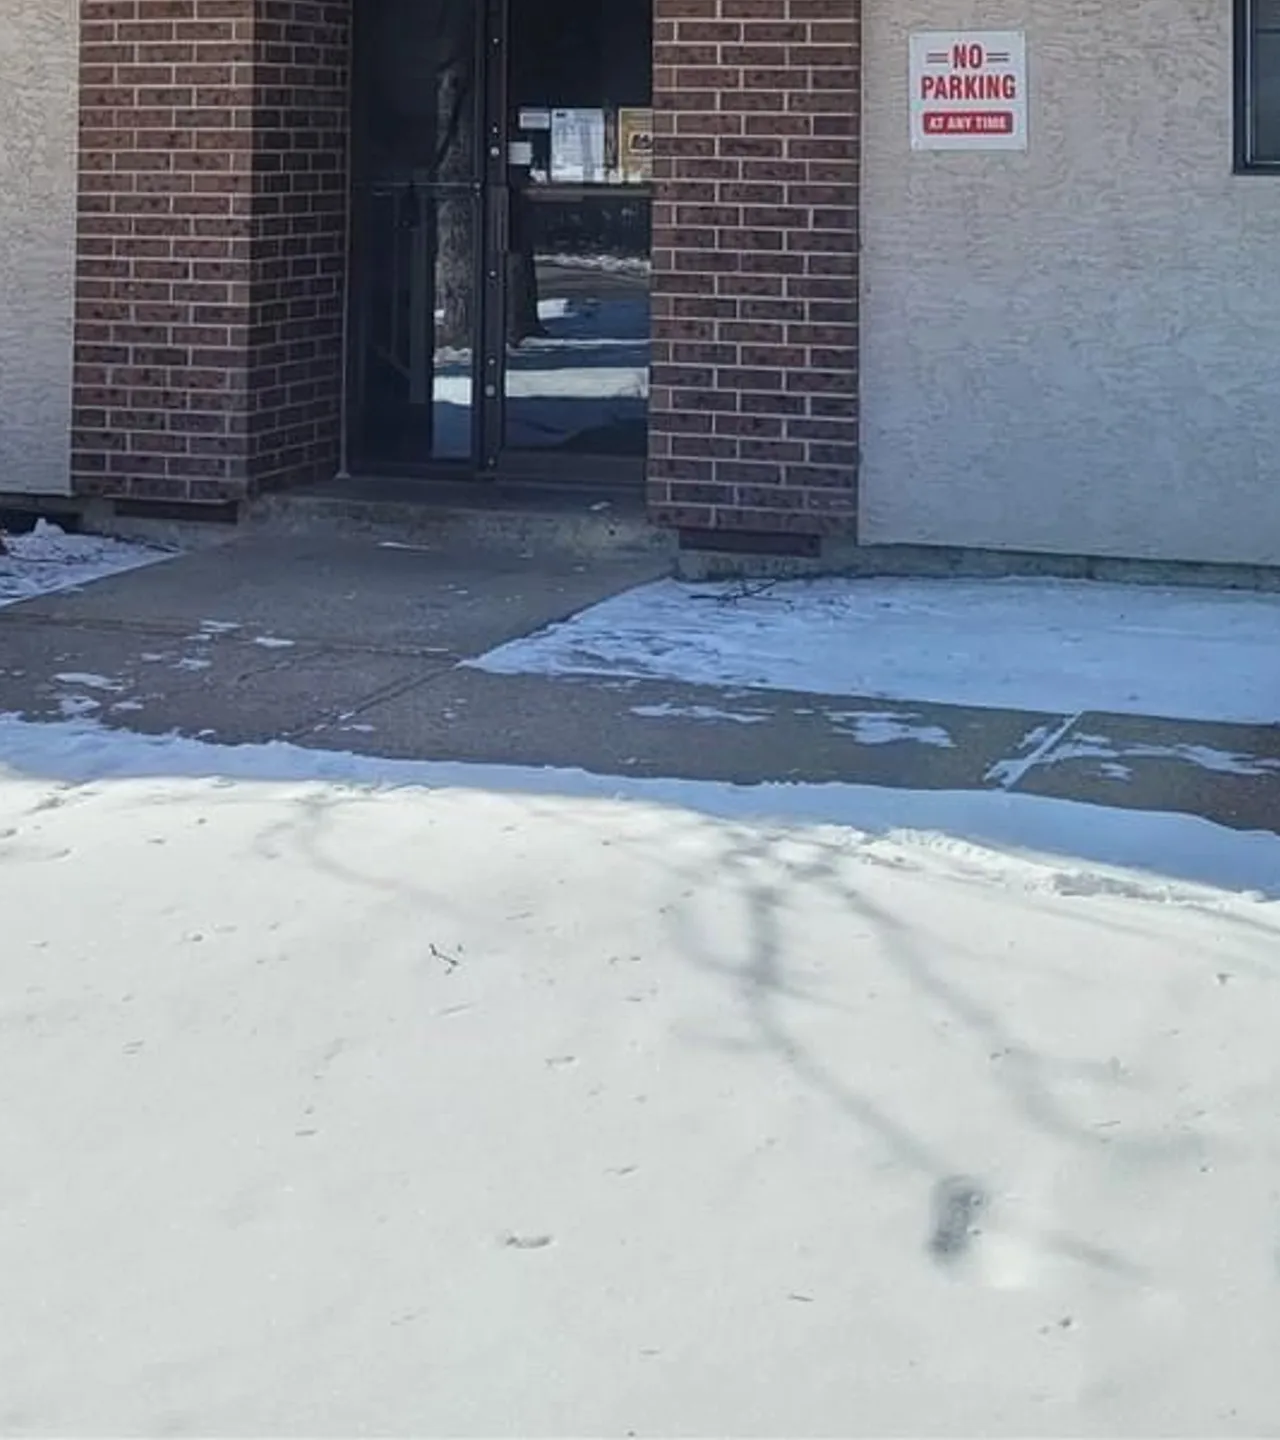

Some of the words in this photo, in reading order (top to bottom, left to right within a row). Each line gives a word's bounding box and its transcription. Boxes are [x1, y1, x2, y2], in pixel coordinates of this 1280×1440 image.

[952, 43, 983, 70] NO
[920, 74, 1017, 101] PARKING
[928, 116, 945, 130] AT
[947, 115, 973, 130] ANY
[975, 115, 1007, 130] TIME
